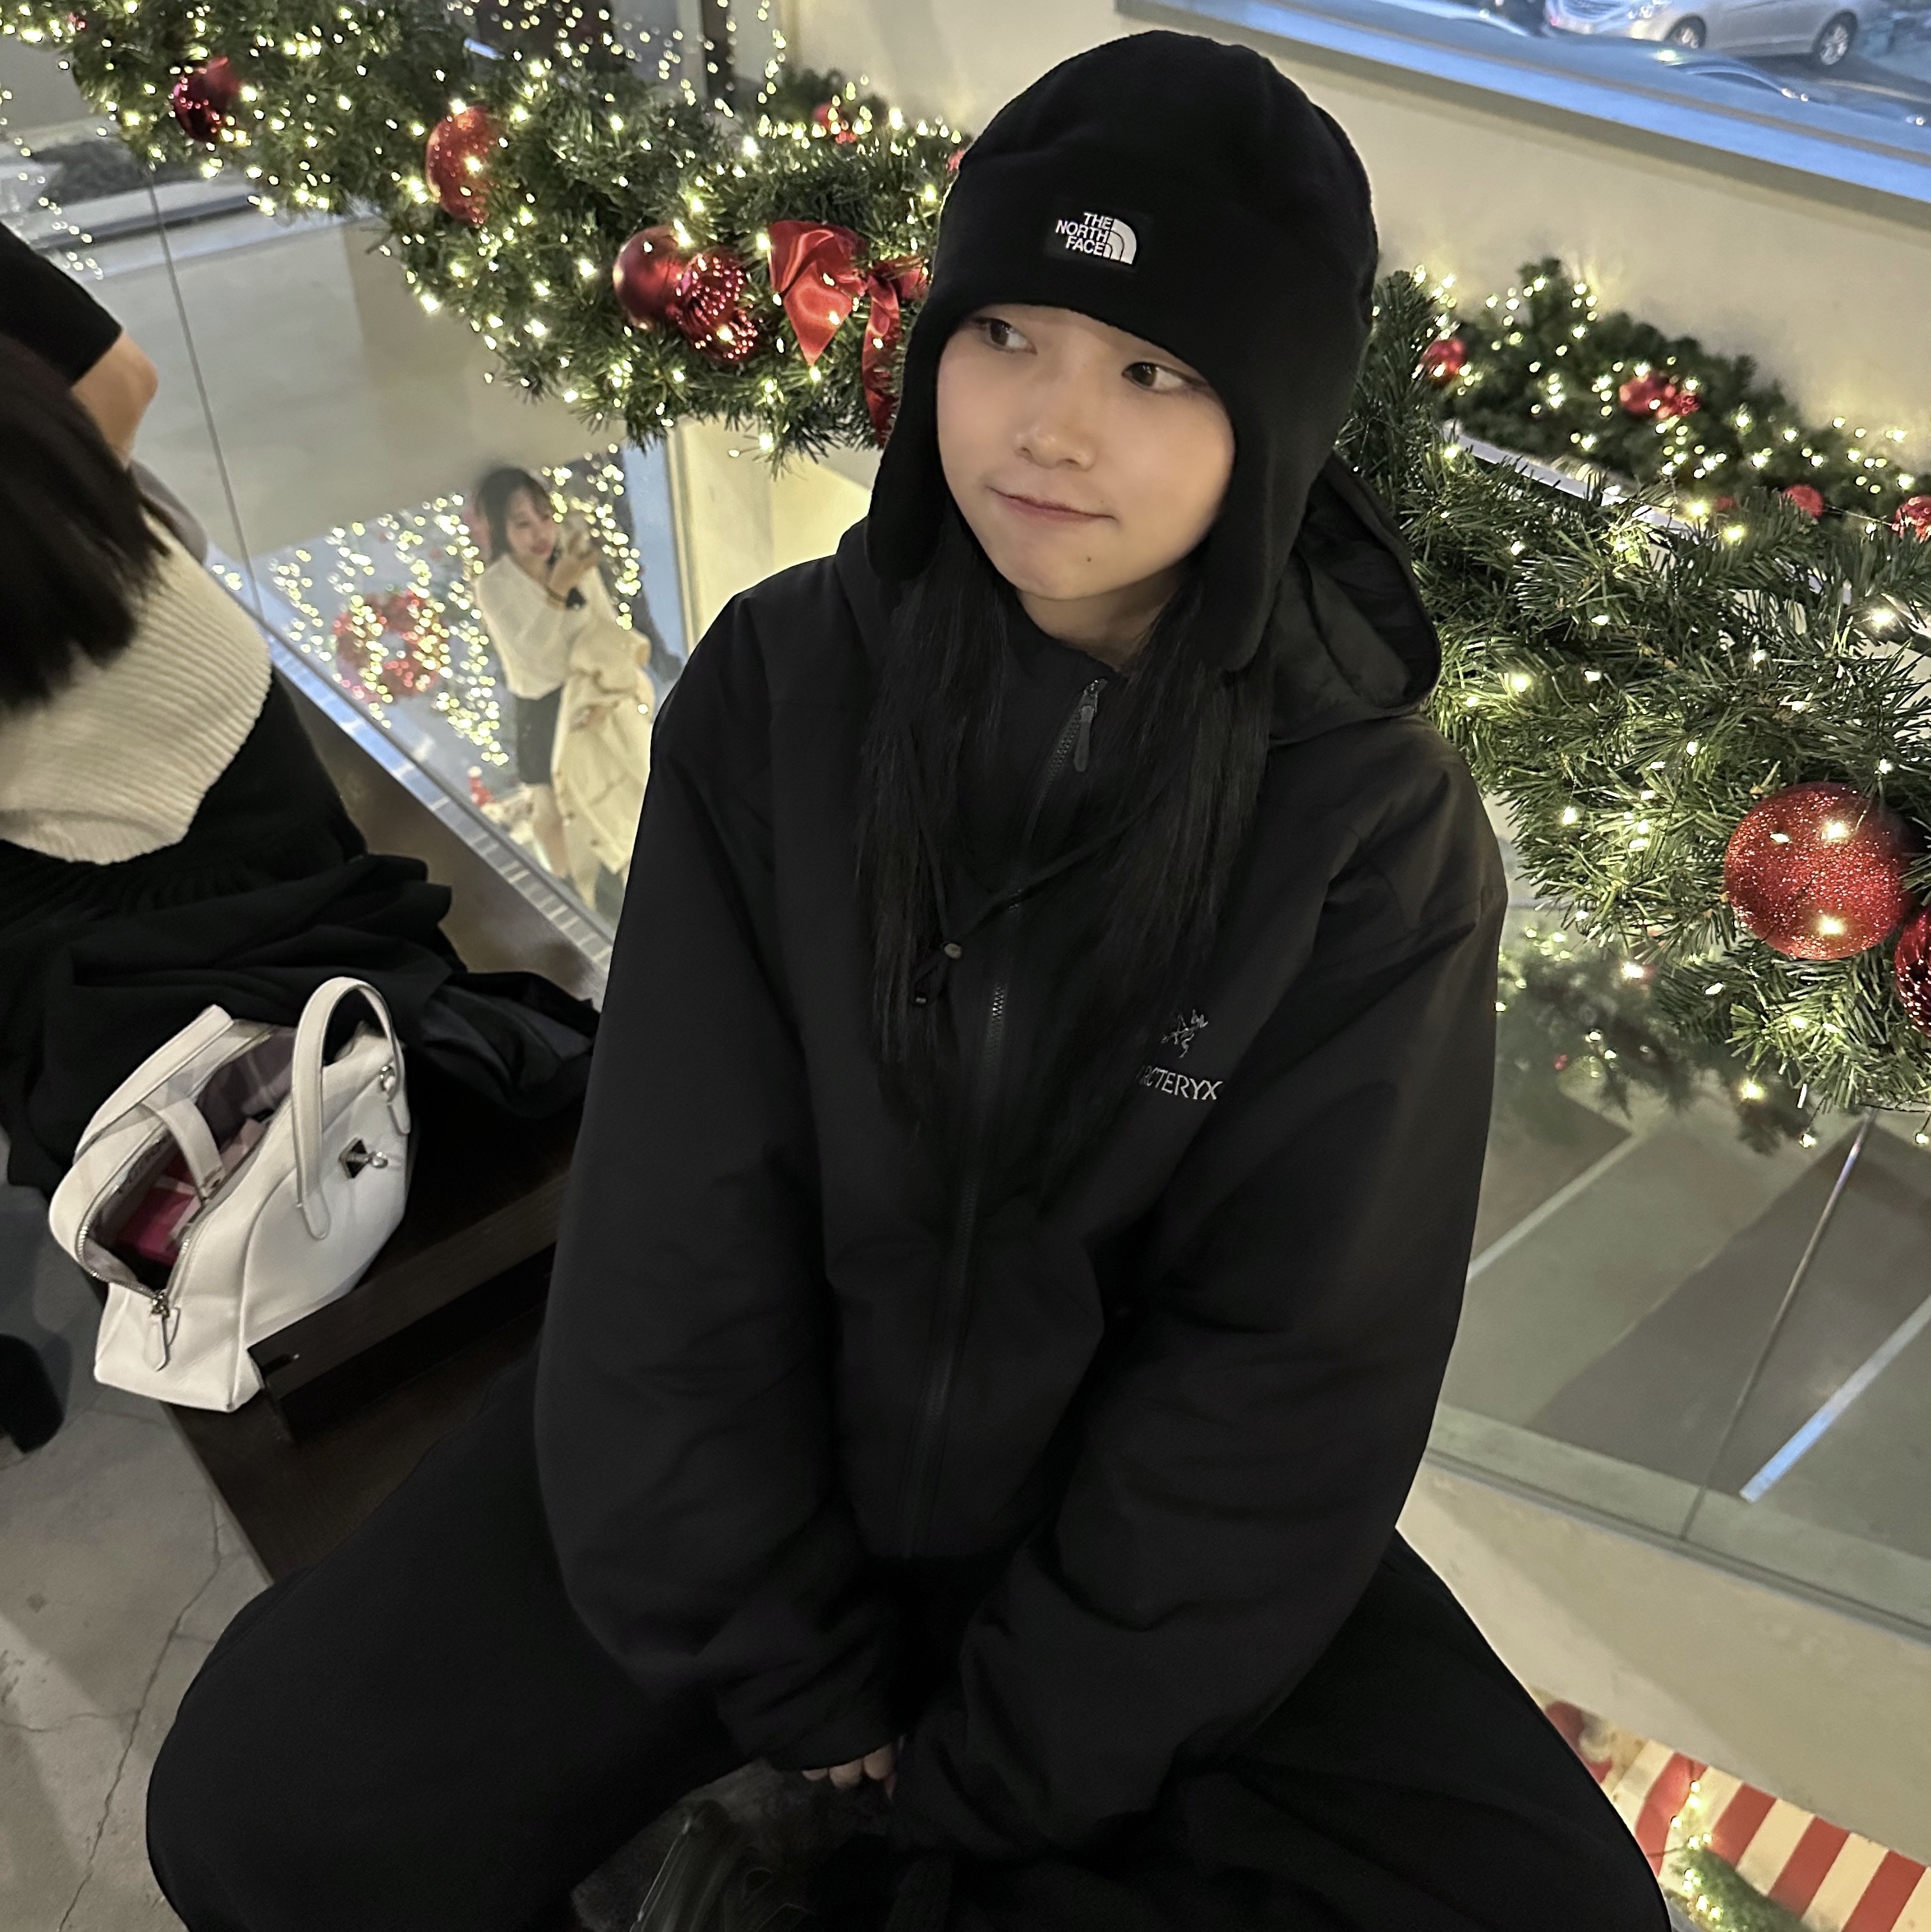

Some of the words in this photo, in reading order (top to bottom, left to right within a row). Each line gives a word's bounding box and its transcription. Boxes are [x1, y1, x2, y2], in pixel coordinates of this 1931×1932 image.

[1083, 212, 1114, 230] THE
[1055, 220, 1109, 243] NORTH
[1065, 235, 1106, 255] FACE
